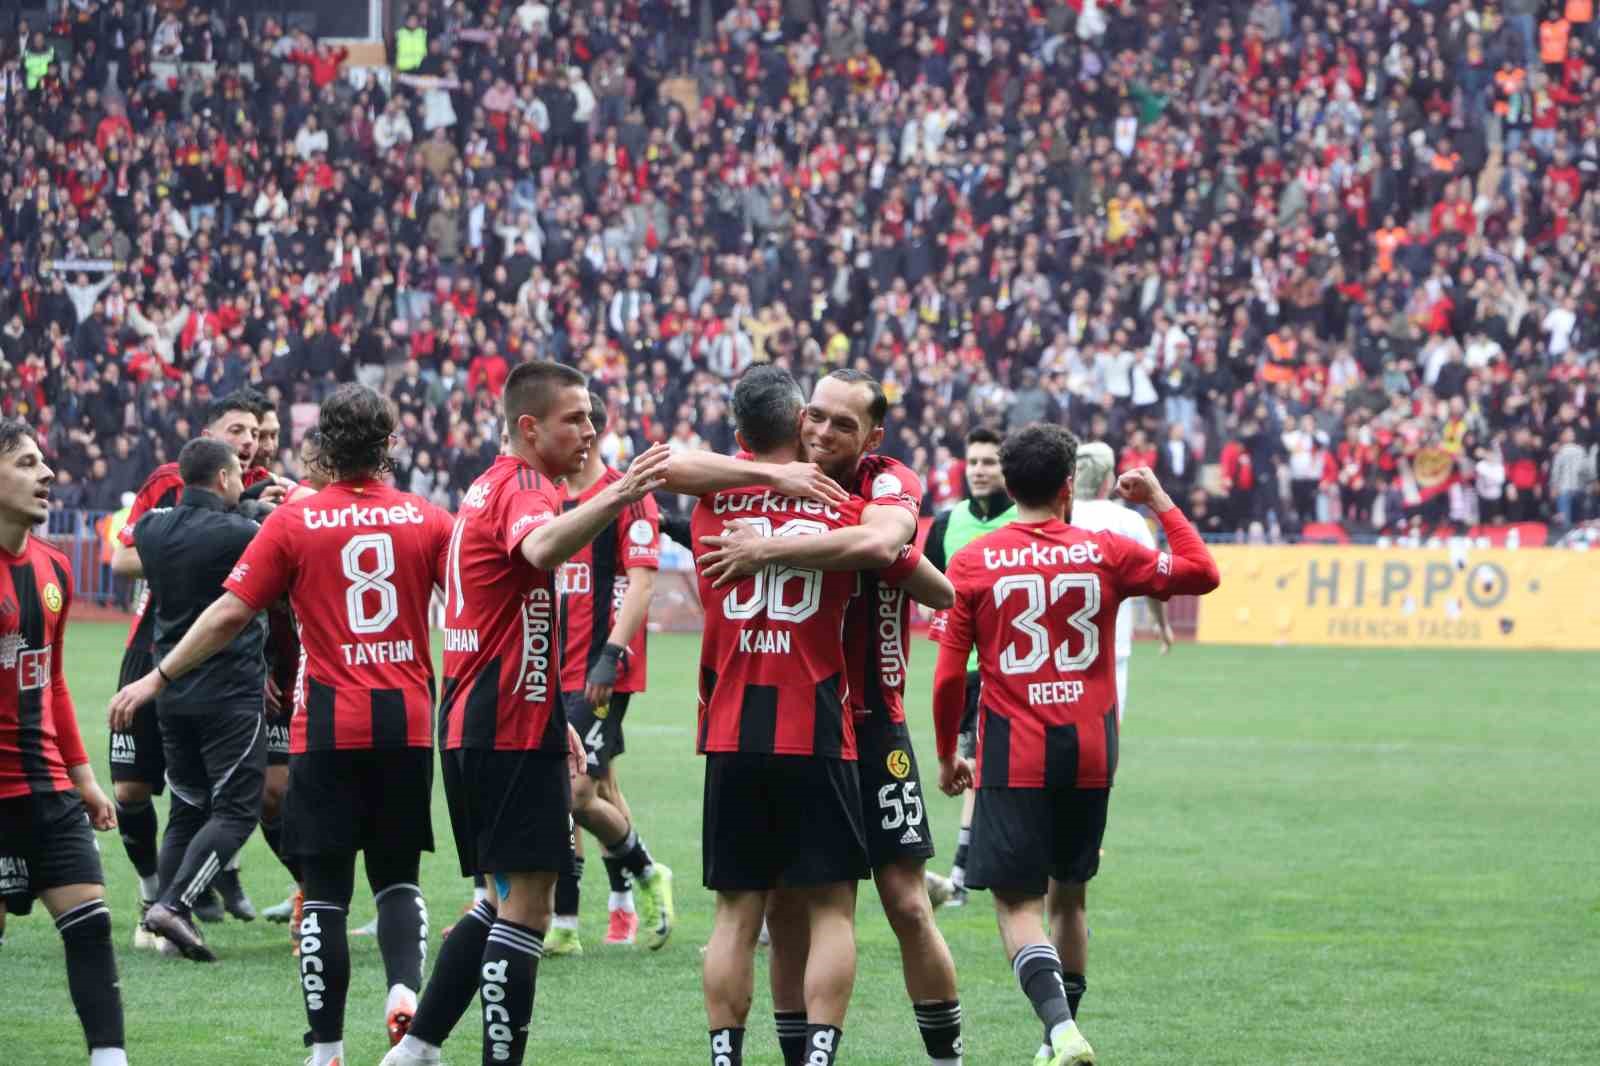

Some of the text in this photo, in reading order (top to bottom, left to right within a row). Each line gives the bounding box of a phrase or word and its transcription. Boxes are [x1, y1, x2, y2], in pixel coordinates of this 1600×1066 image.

[304, 501, 424, 529] turknet
[983, 540, 1103, 570] turknet
[341, 533, 398, 634] 8
[1306, 559, 1509, 608] HIPPO
[992, 573, 1103, 676] 33
[341, 639, 414, 666] TAYFUN
[524, 588, 550, 703] EUROPEN
[739, 629, 791, 654] KAAN
[1028, 680, 1084, 705] RECEP
[585, 719, 605, 751] 4
[878, 781, 923, 830] 55
